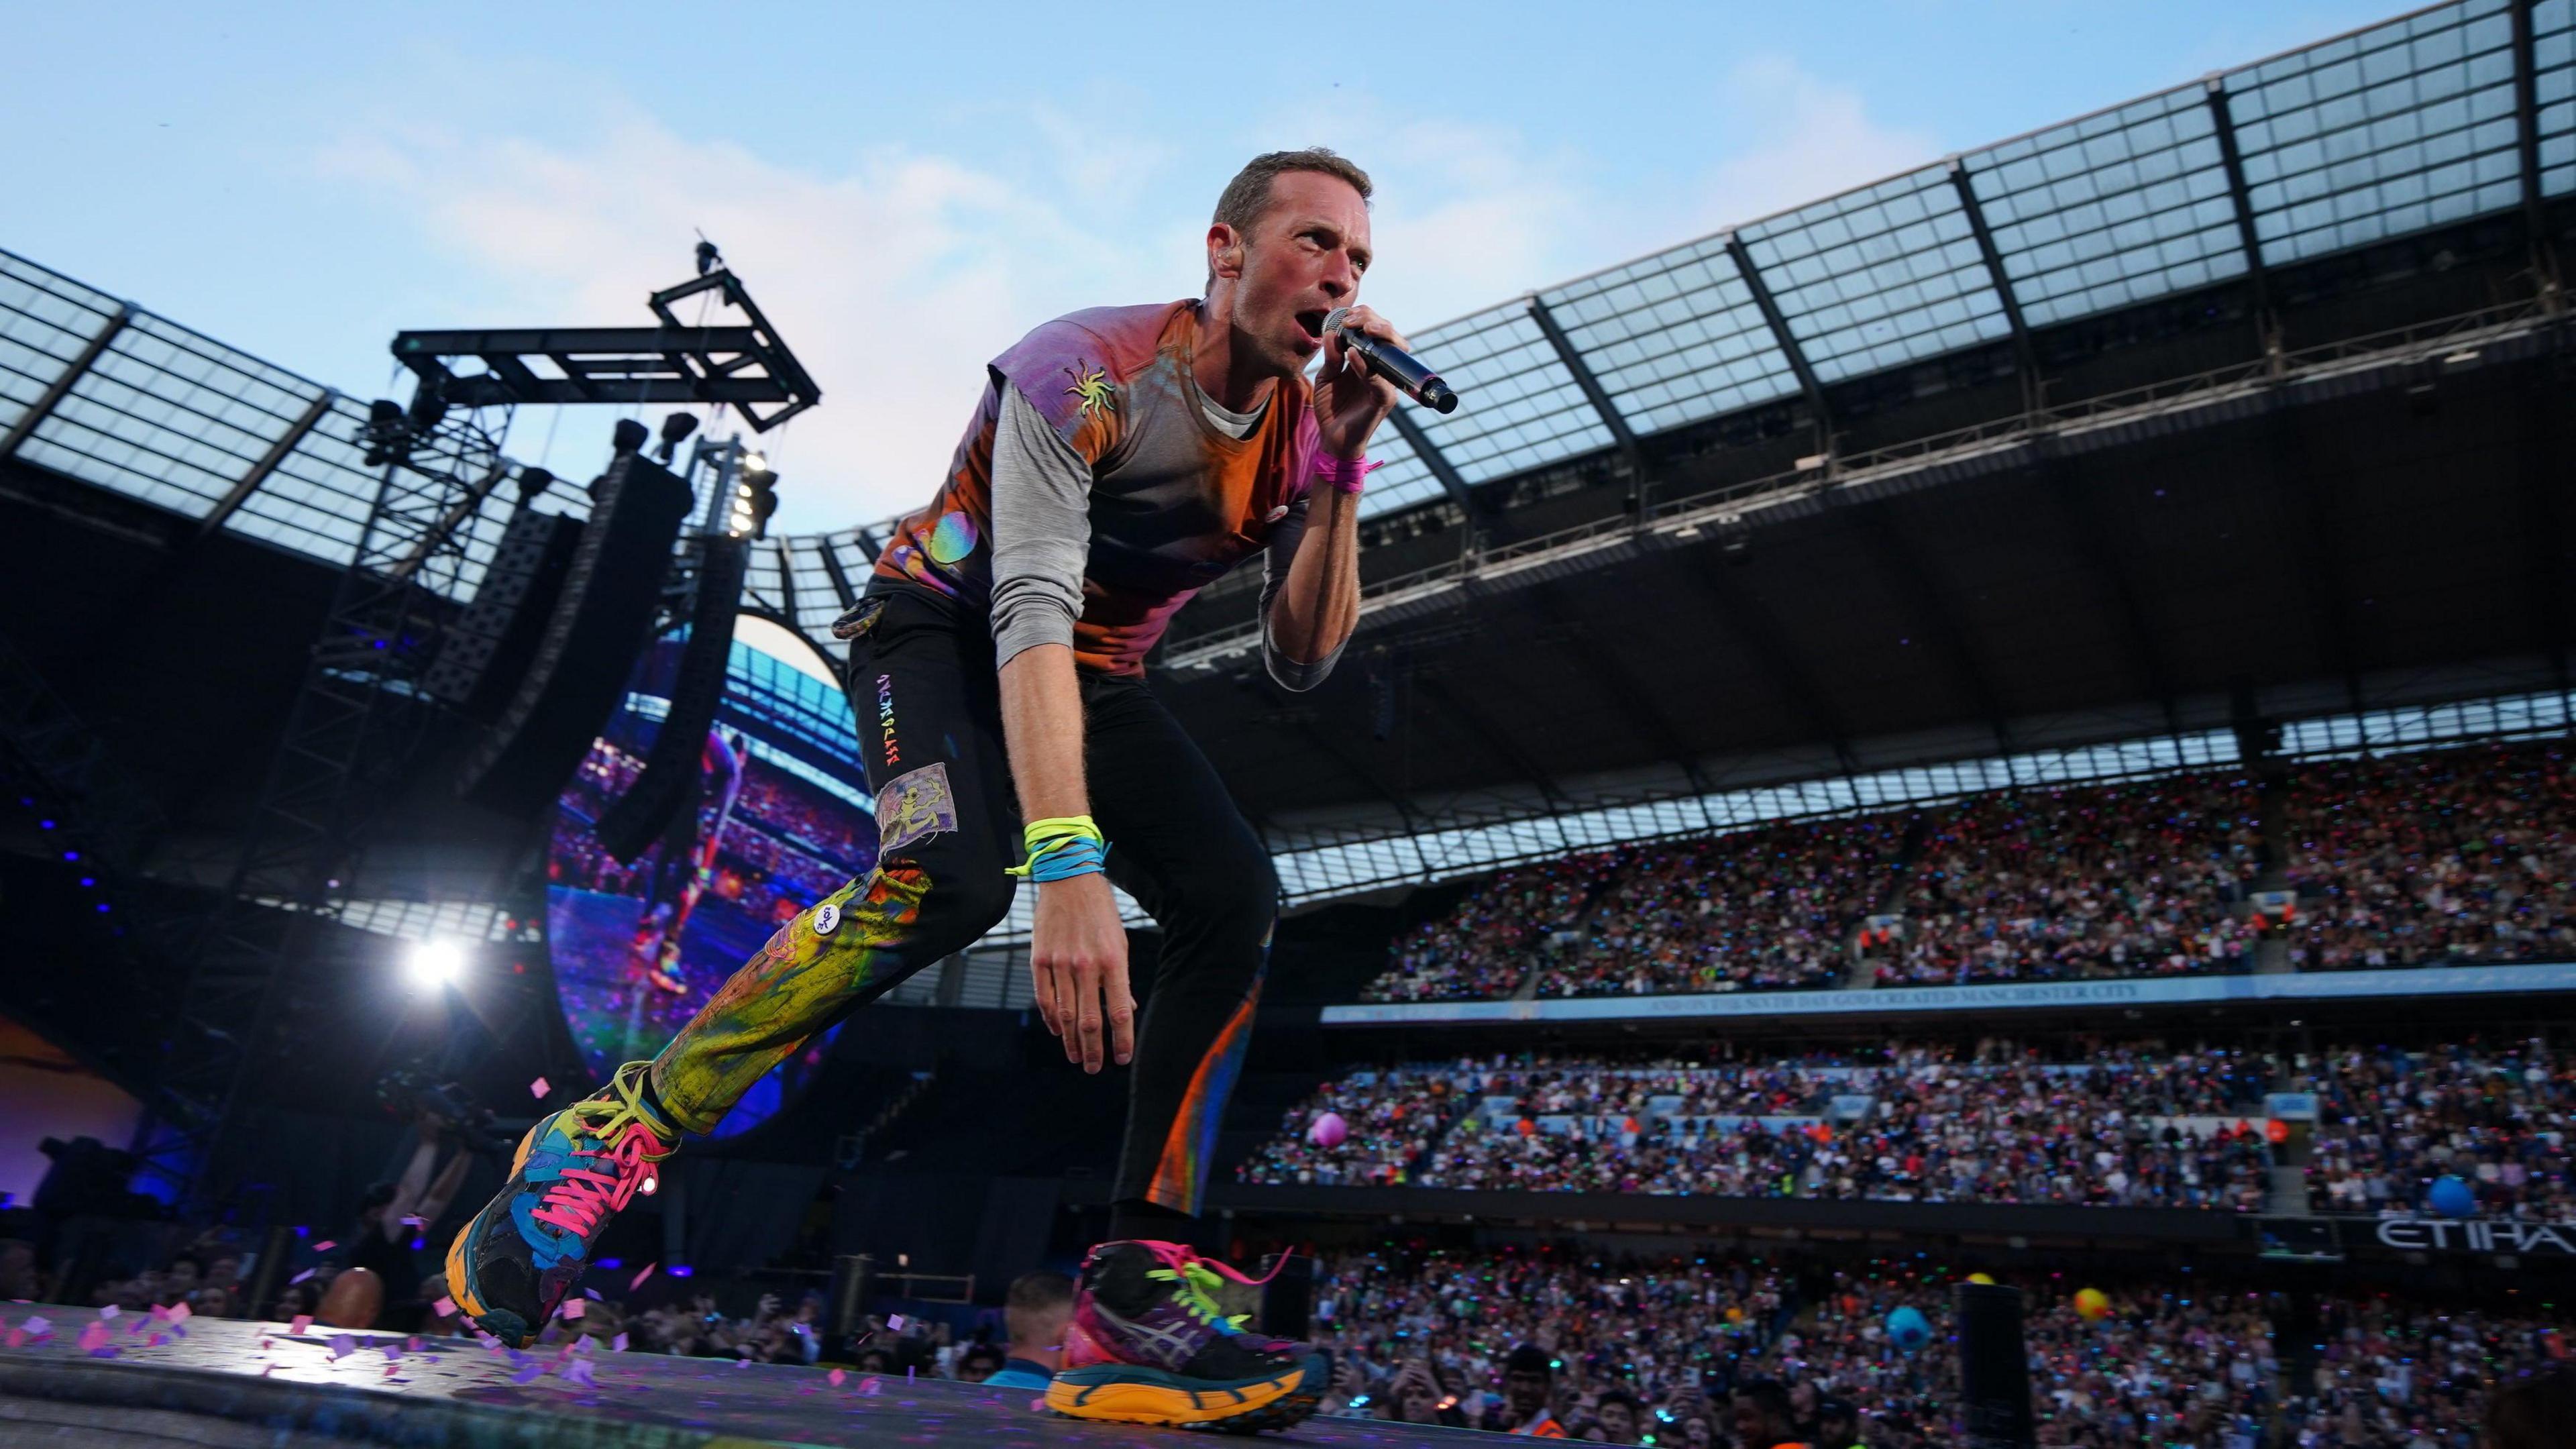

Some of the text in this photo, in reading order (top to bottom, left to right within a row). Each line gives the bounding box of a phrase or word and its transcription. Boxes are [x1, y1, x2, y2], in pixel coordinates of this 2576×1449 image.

[817, 906, 832, 930] LOVE
[1798, 994, 1827, 1006] DAY
[1833, 993, 1872, 1006] GOD
[1874, 990, 1957, 1004] CREATED
[1960, 986, 2088, 1002] MANCHESTER
[2092, 984, 2137, 997] CITY
[2376, 1220, 2576, 1253] ETIHA
